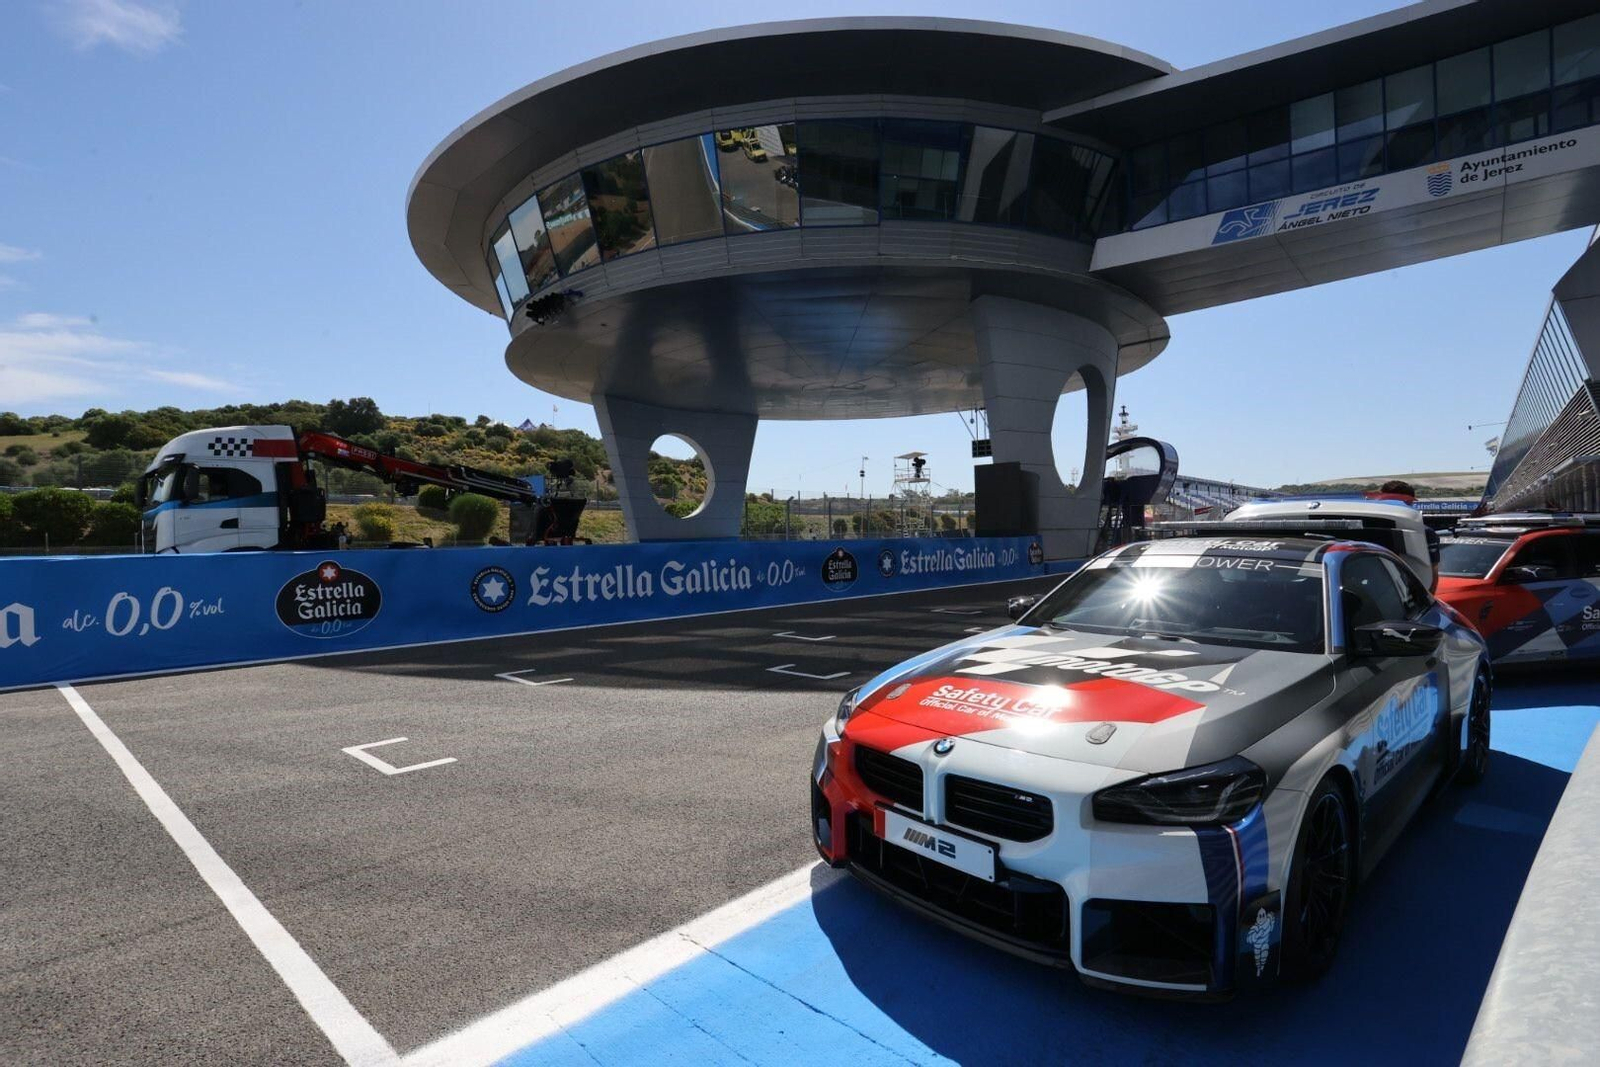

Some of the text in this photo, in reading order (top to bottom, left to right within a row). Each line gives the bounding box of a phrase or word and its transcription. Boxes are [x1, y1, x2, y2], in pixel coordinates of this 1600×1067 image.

[1460, 138, 1578, 173] Ayuntamiento
[1460, 163, 1524, 184] de Jerez
[1283, 187, 1380, 220] JEREZ
[1278, 205, 1371, 232] ÁNGEL NIETO
[828, 560, 852, 570] Estrella
[900, 550, 953, 574] Estrella
[954, 547, 995, 570] Galicia
[1196, 556, 1274, 571] OWER
[528, 565, 654, 606] Estrella
[660, 558, 752, 596] Galicia
[767, 559, 794, 586] 0,0
[829, 569, 852, 580] Galicia
[295, 582, 365, 602] Estrella
[62, 609, 100, 632] alc.
[105, 586, 184, 636] 0,0
[298, 599, 362, 620] Galicia
[919, 699, 992, 717] Official Car of
[932, 685, 1009, 711] Safety
